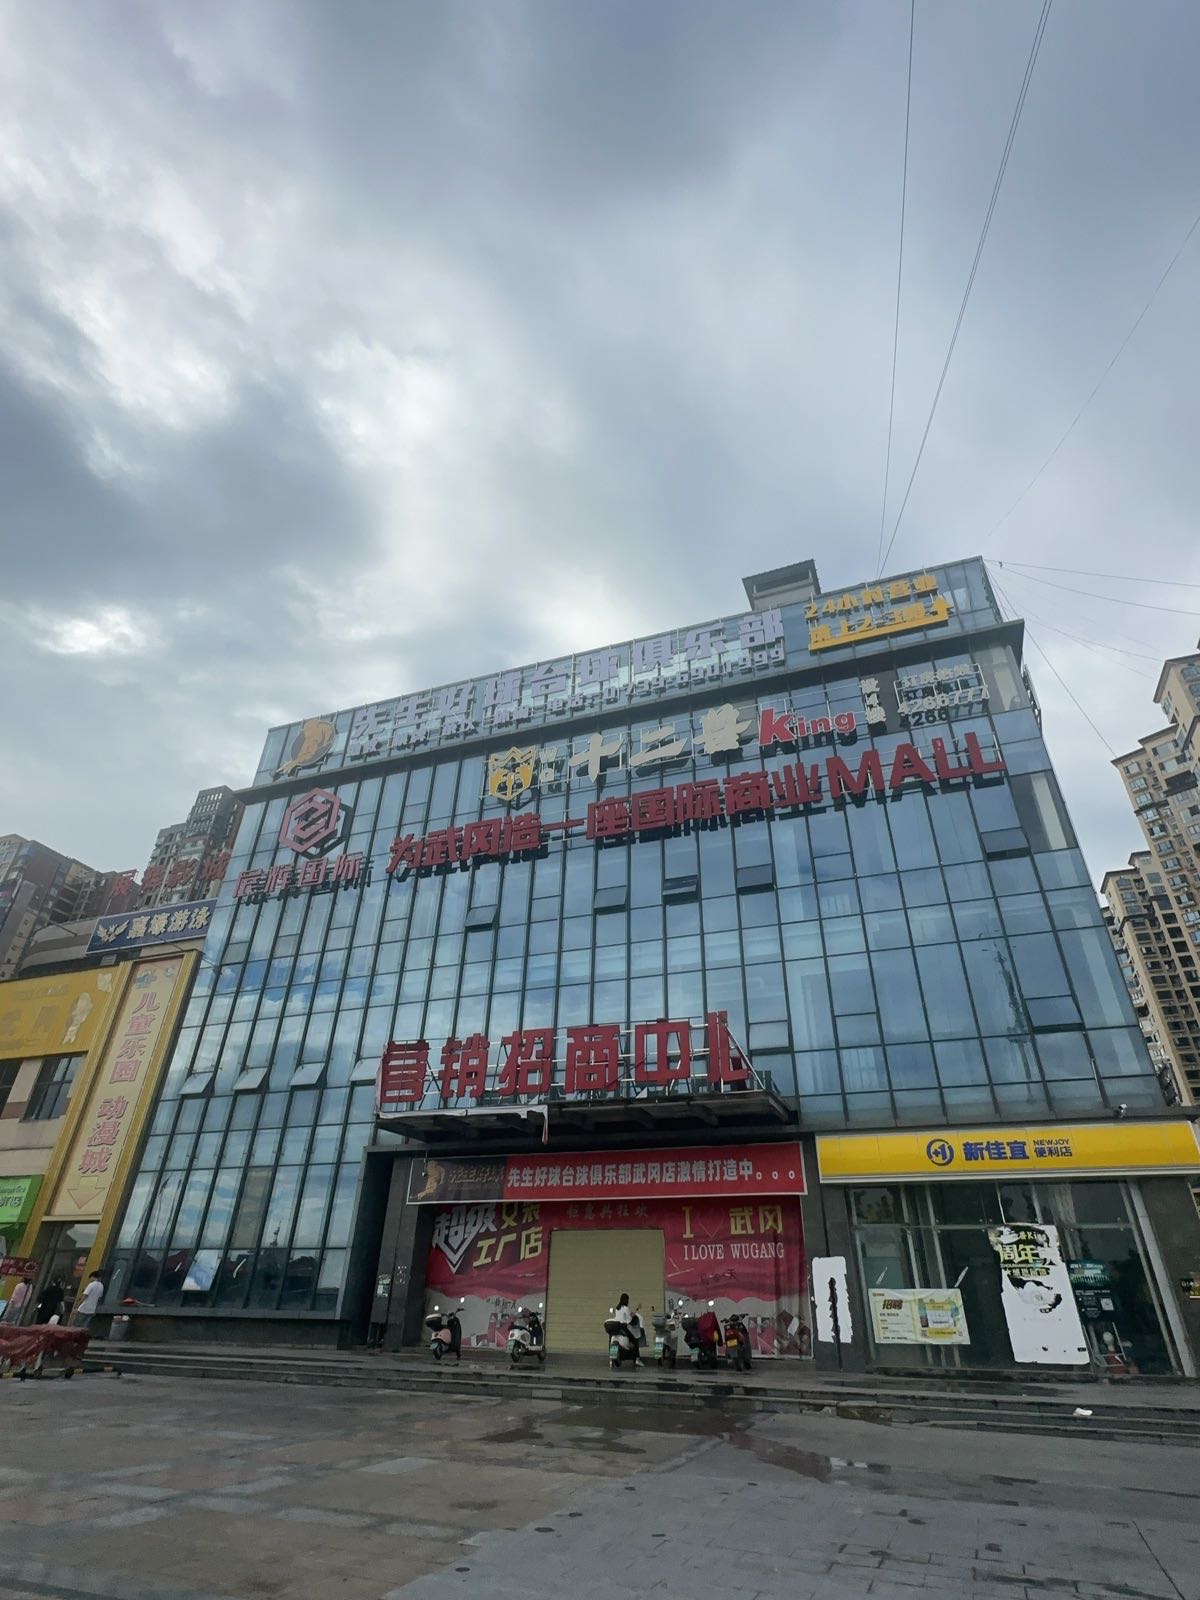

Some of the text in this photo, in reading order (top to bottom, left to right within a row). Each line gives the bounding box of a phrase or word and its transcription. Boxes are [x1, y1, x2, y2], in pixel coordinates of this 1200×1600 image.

[78, 991, 160, 1173] 儿童乐园 动漫城
[963, 1139, 1030, 1161] 新佳宜
[1033, 1138, 1070, 1146] NEWJOY
[1033, 1146, 1073, 1158] 便利店
[728, 1205, 784, 1235] 武冈
[472, 1226, 543, 1268] 工厂店
[691, 1244, 725, 1260] LOVE
[730, 1242, 785, 1259] WUGANG
